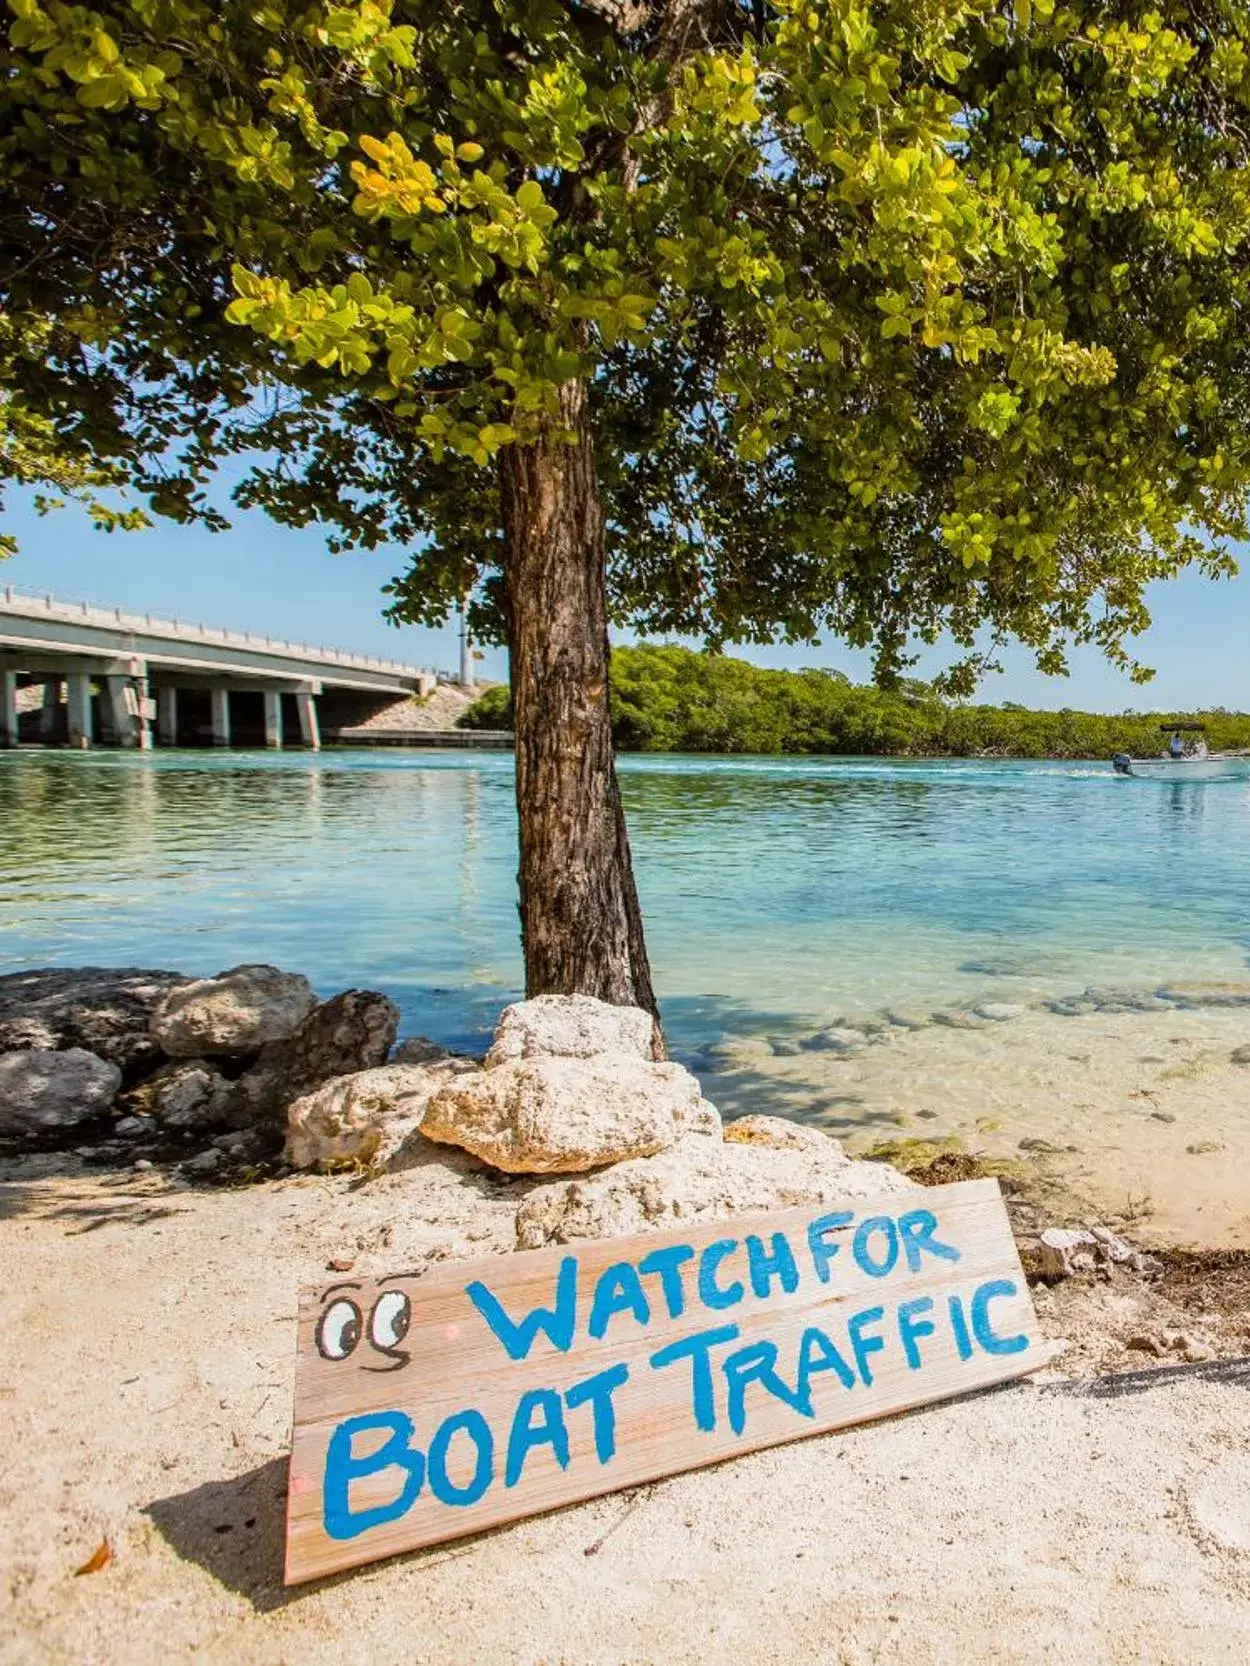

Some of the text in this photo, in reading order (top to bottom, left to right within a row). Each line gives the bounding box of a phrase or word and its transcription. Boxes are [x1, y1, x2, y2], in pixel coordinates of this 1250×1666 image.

[466, 1210, 961, 1360] WATCH FOR
[323, 1279, 1029, 1540] BOAT TRAFFIC
